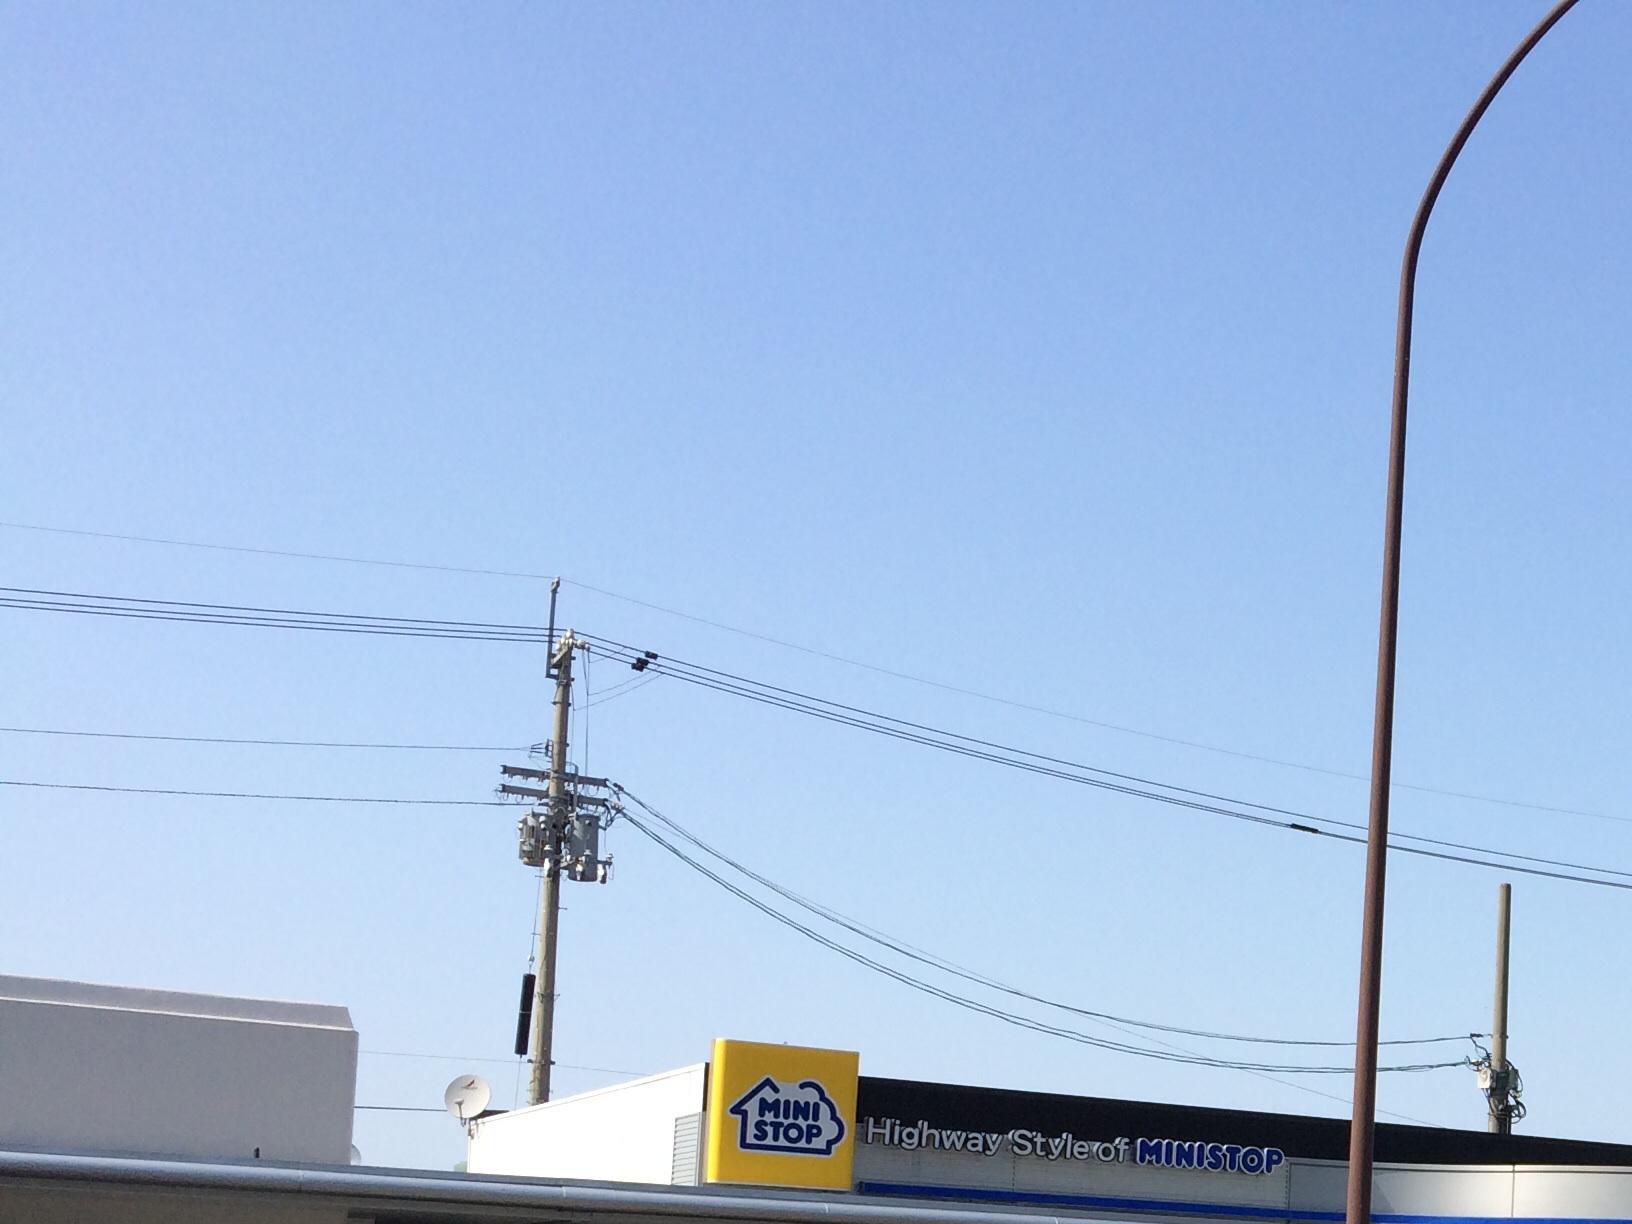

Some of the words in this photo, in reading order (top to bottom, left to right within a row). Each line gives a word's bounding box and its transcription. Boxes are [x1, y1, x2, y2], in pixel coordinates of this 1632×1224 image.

[757, 1096, 821, 1123] MINI
[753, 1119, 823, 1146] STOP
[864, 1117, 1001, 1156] Highway
[1011, 1128, 1090, 1162] Style
[1093, 1137, 1131, 1163] of
[1135, 1138, 1286, 1175] MINISTOP
